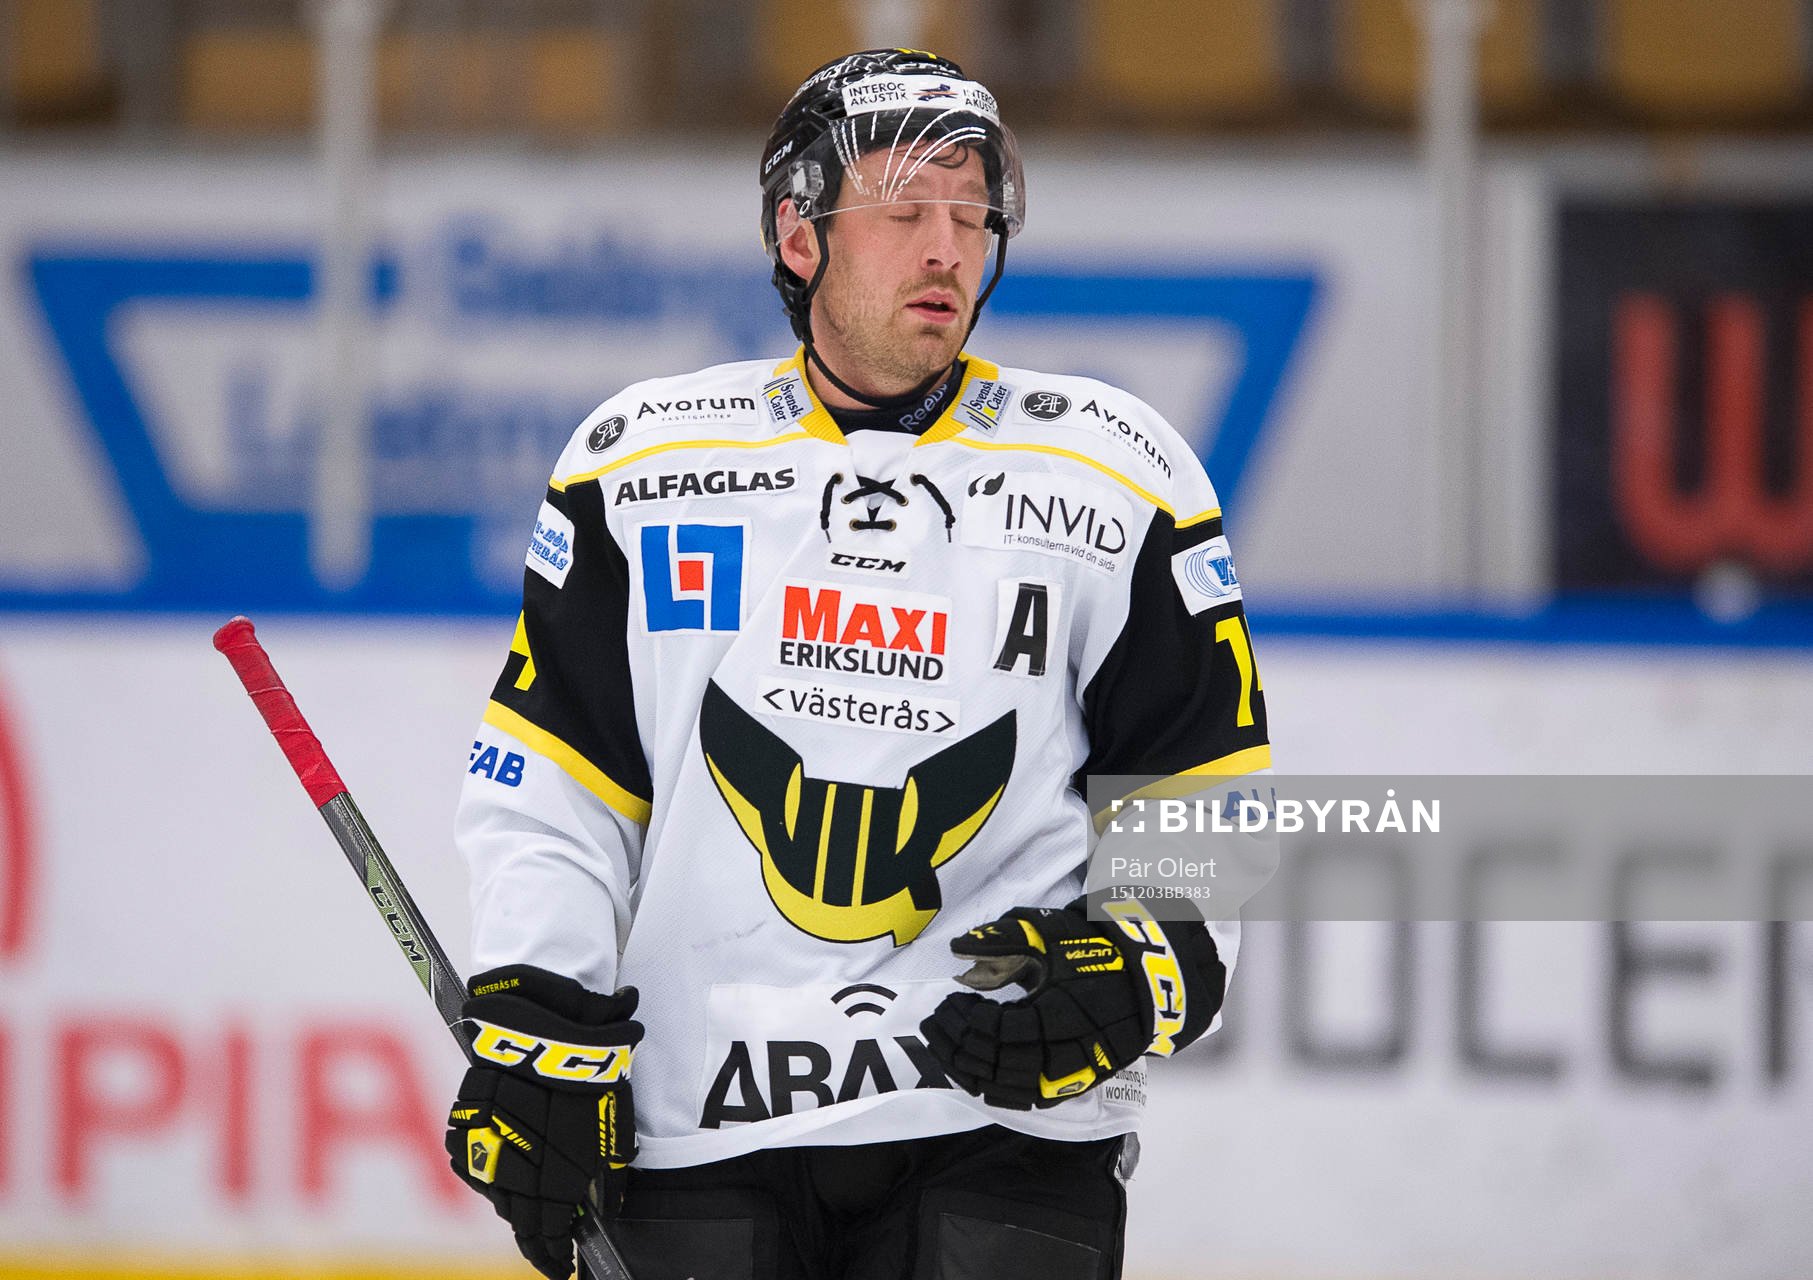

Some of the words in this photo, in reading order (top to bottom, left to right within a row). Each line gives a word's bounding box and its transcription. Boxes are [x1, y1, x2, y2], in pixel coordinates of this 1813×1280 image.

[849, 82, 906, 97] INTEROC
[851, 92, 909, 106] AKUSTIK
[765, 140, 793, 174] CCM
[637, 397, 756, 420] Avorum
[770, 396, 787, 420] Cater
[781, 384, 804, 418] Svensk
[969, 381, 995, 410] Svensk
[987, 386, 1007, 410] Cater
[1080, 400, 1172, 480] Avorum
[615, 468, 795, 506] ALFAGLAS
[1005, 494, 1126, 555] INVID
[830, 552, 907, 573] CCM
[782, 585, 948, 656] MAXI
[993, 582, 1049, 676] A
[780, 641, 943, 681] ERIKSLUND
[370, 885, 427, 962] CCM
[510, 978, 520, 988] IK
[1101, 898, 1187, 1058] CCM
[0, 1005, 472, 1215] PIA
